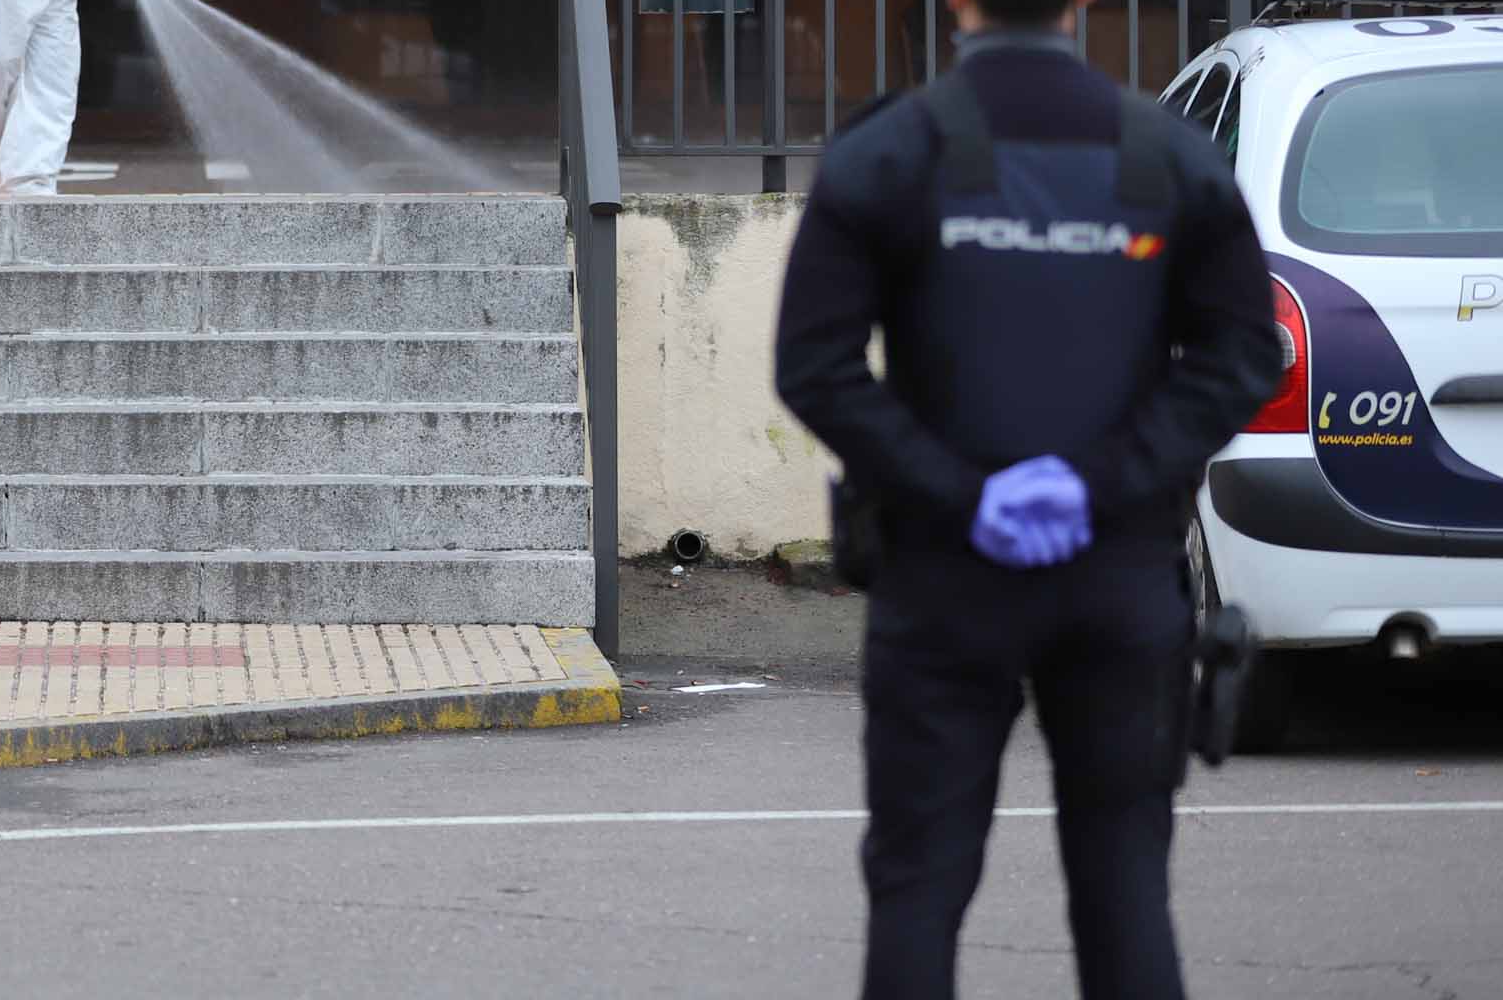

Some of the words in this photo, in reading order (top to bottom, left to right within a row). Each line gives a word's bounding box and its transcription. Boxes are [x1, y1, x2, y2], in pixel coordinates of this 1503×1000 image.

[941, 216, 1131, 255] POLICIA
[1349, 391, 1417, 426] 091
[1318, 433, 1414, 447] www.policia.es
